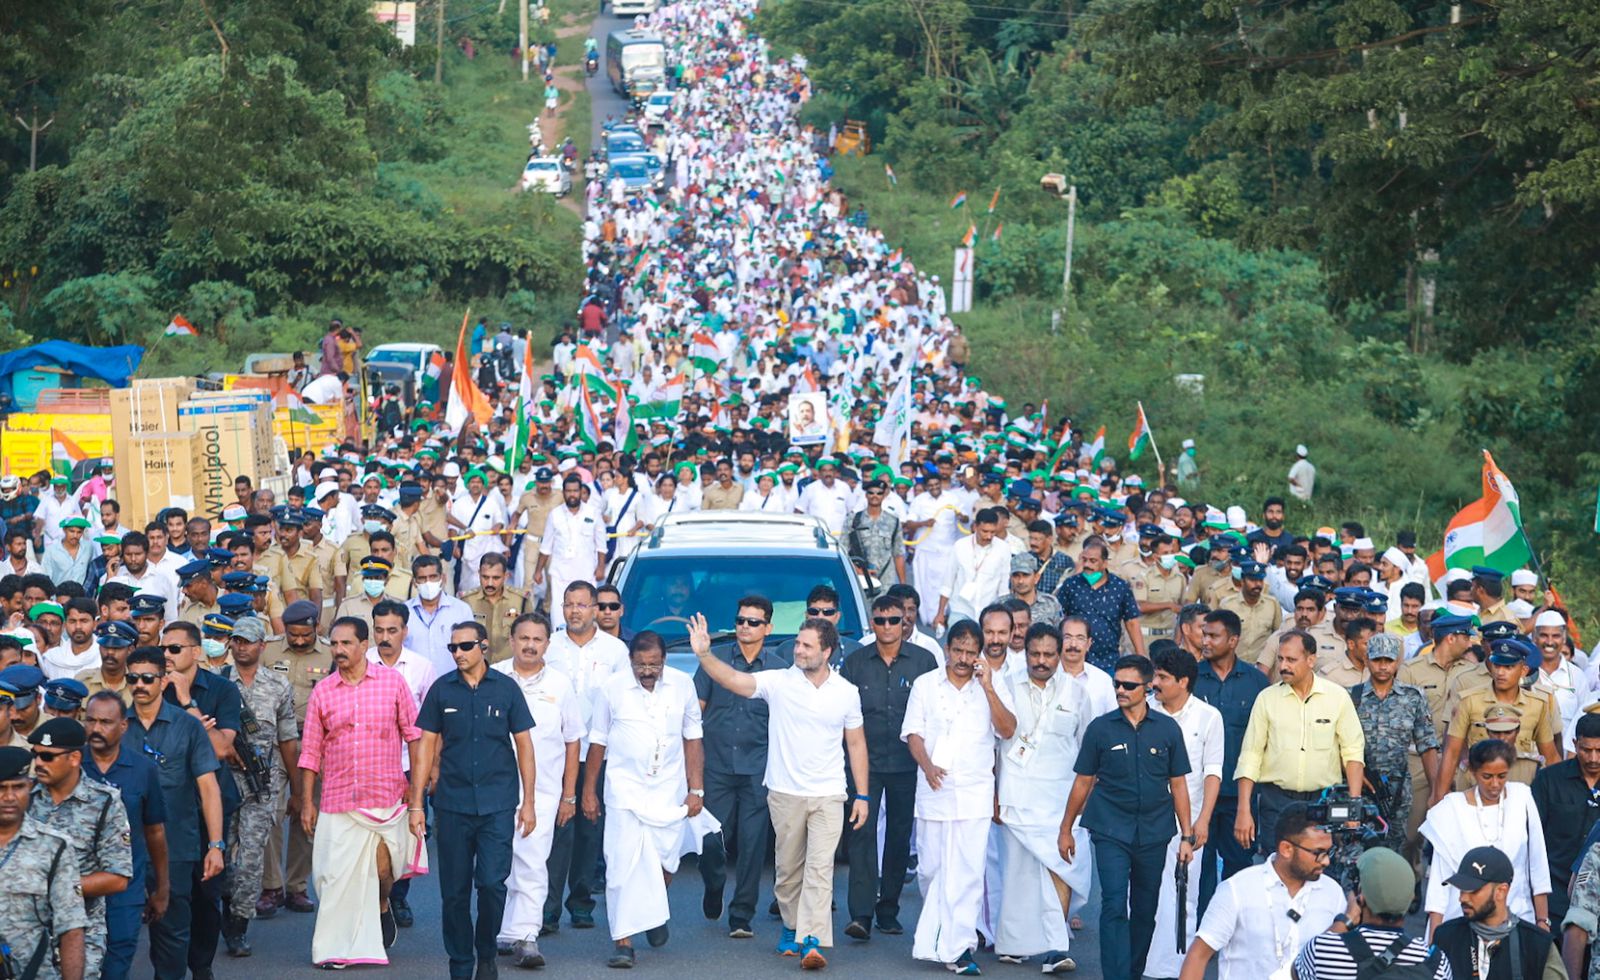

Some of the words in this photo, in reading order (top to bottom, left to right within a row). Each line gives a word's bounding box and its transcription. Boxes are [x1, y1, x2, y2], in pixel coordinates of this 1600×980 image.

[129, 422, 159, 432] Haier
[144, 459, 174, 469] Haier
[200, 425, 231, 522] Whirlpool
